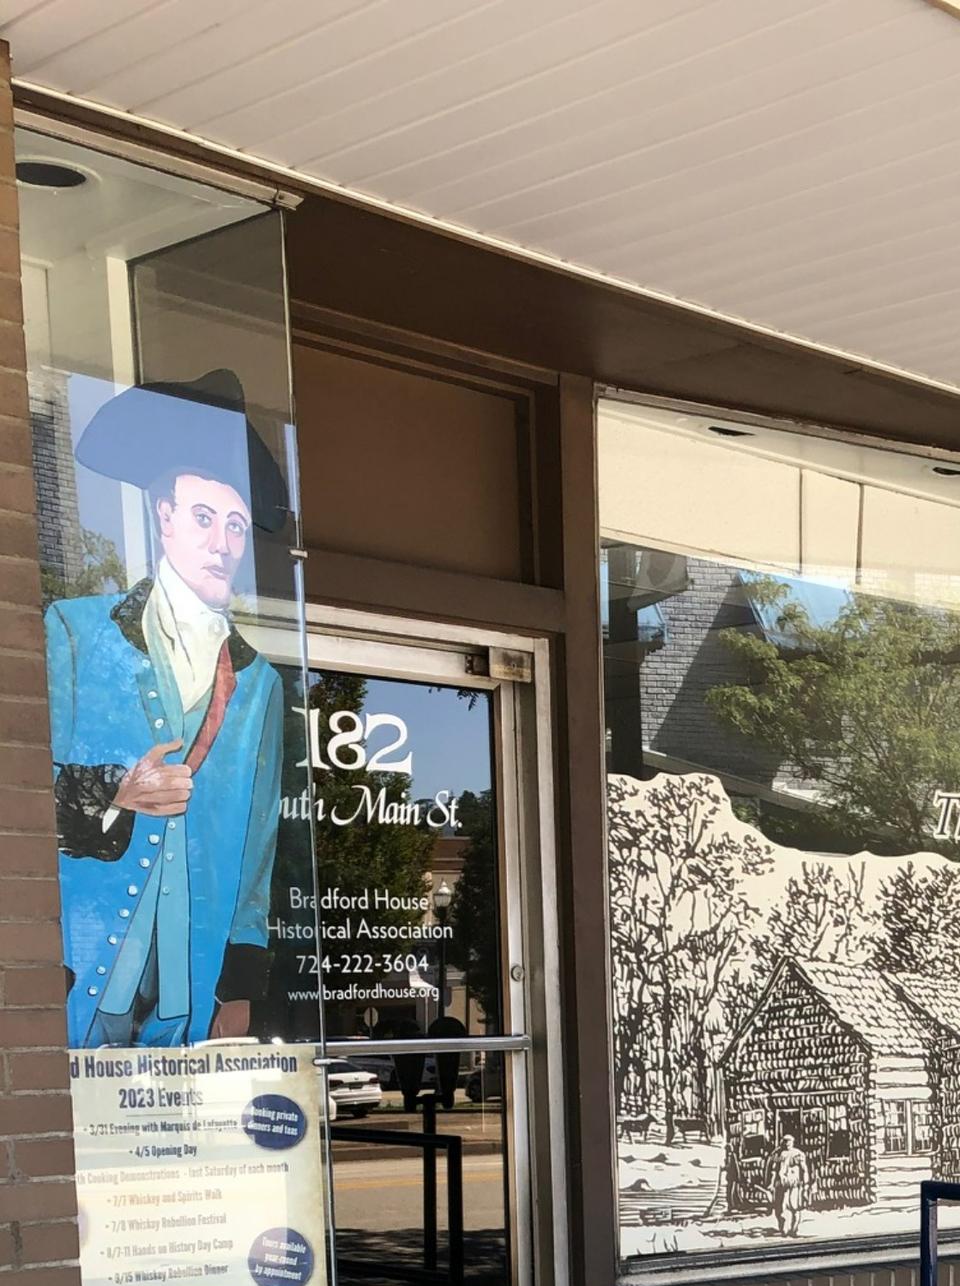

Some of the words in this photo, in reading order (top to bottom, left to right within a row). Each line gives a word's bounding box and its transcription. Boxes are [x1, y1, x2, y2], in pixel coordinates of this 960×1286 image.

[292, 706, 412, 775] 182
[279, 783, 324, 822] uth
[330, 785, 421, 826] Main
[427, 790, 463, 828] St.
[289, 887, 369, 911] Bradford
[374, 889, 429, 911] House
[356, 918, 453, 940] Association
[296, 954, 429, 974] 724-222-3604
[288, 985, 439, 1001] wwwbradfordhouse.org
[85, 1056, 133, 1078] House
[137, 1054, 210, 1076] Historical
[215, 1052, 297, 1074] Association
[118, 1087, 155, 1109] 2023
[158, 1086, 204, 1107] Events
[109, 1122, 140, 1136] Evening
[142, 1121, 158, 1132] with
[160, 1120, 190, 1133] Marquis
[272, 1123, 284, 1134] and
[135, 1146, 150, 1158] 4/5
[151, 1145, 182, 1158] Opening
[183, 1144, 197, 1156] Day
[87, 1171, 118, 1185] Cooking
[120, 1169, 180, 1182] Demonstrations
[204, 1164, 237, 1178] Saturday
[239, 1164, 247, 1175] of
[248, 1163, 265, 1174] each
[266, 1162, 289, 1173] month
[128, 1194, 160, 1206] Whiskey
[162, 1191, 176, 1203] and
[177, 1190, 203, 1204] Spirits
[204, 1188, 222, 1200] Walk
[127, 1218, 160, 1232] Whiskey
[161, 1215, 196, 1228] Rebellion
[197, 1213, 227, 1225] Festival
[132, 1244, 156, 1257] Hands
[158, 1245, 167, 1255] on
[168, 1241, 196, 1254] History
[197, 1239, 211, 1253] Day
[212, 1238, 233, 1251] Camp
[134, 1270, 167, 1282] Whiskey
[168, 1266, 203, 1279] Rebellion
[204, 1264, 228, 1276] Dinner
